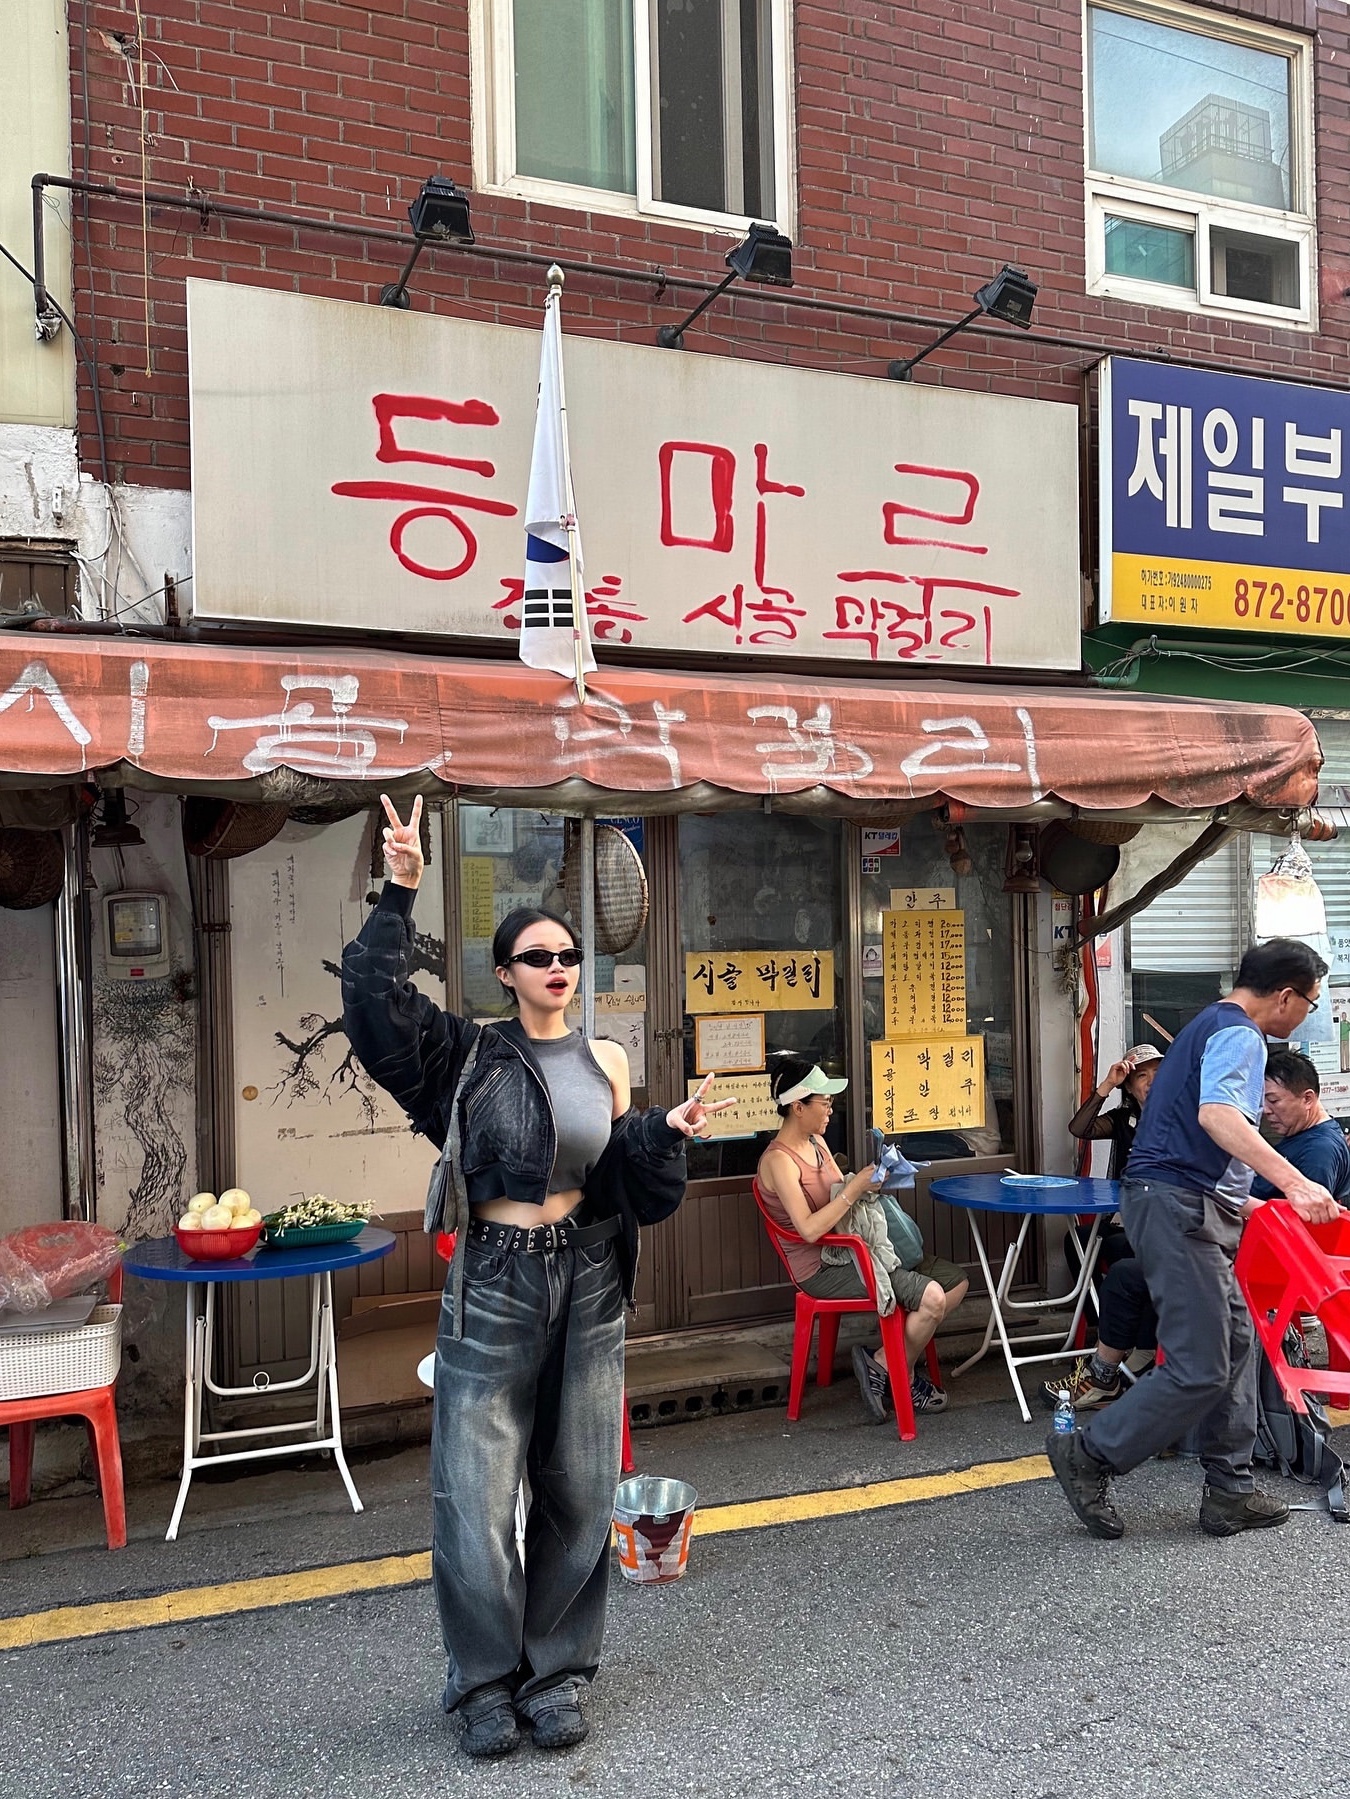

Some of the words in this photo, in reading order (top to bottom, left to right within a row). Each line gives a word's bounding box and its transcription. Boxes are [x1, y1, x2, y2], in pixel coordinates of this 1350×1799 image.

[1128, 399, 1344, 543] 제일부
[1234, 578, 1350, 625] 872-870
[683, 584, 806, 645] 시골
[823, 596, 991, 665] 막걸리
[0, 660, 452, 776] 시골
[552, 697, 1043, 800] 막걸리
[904, 891, 946, 909] 안주
[693, 959, 743, 996] 시골
[756, 957, 821, 998] 막걸리
[883, 1046, 896, 1082] 시골
[917, 1046, 973, 1071] 막걸리
[883, 1085, 896, 1132] 막걸리
[918, 1079, 976, 1097] 안주
[903, 1105, 939, 1123] 포장
